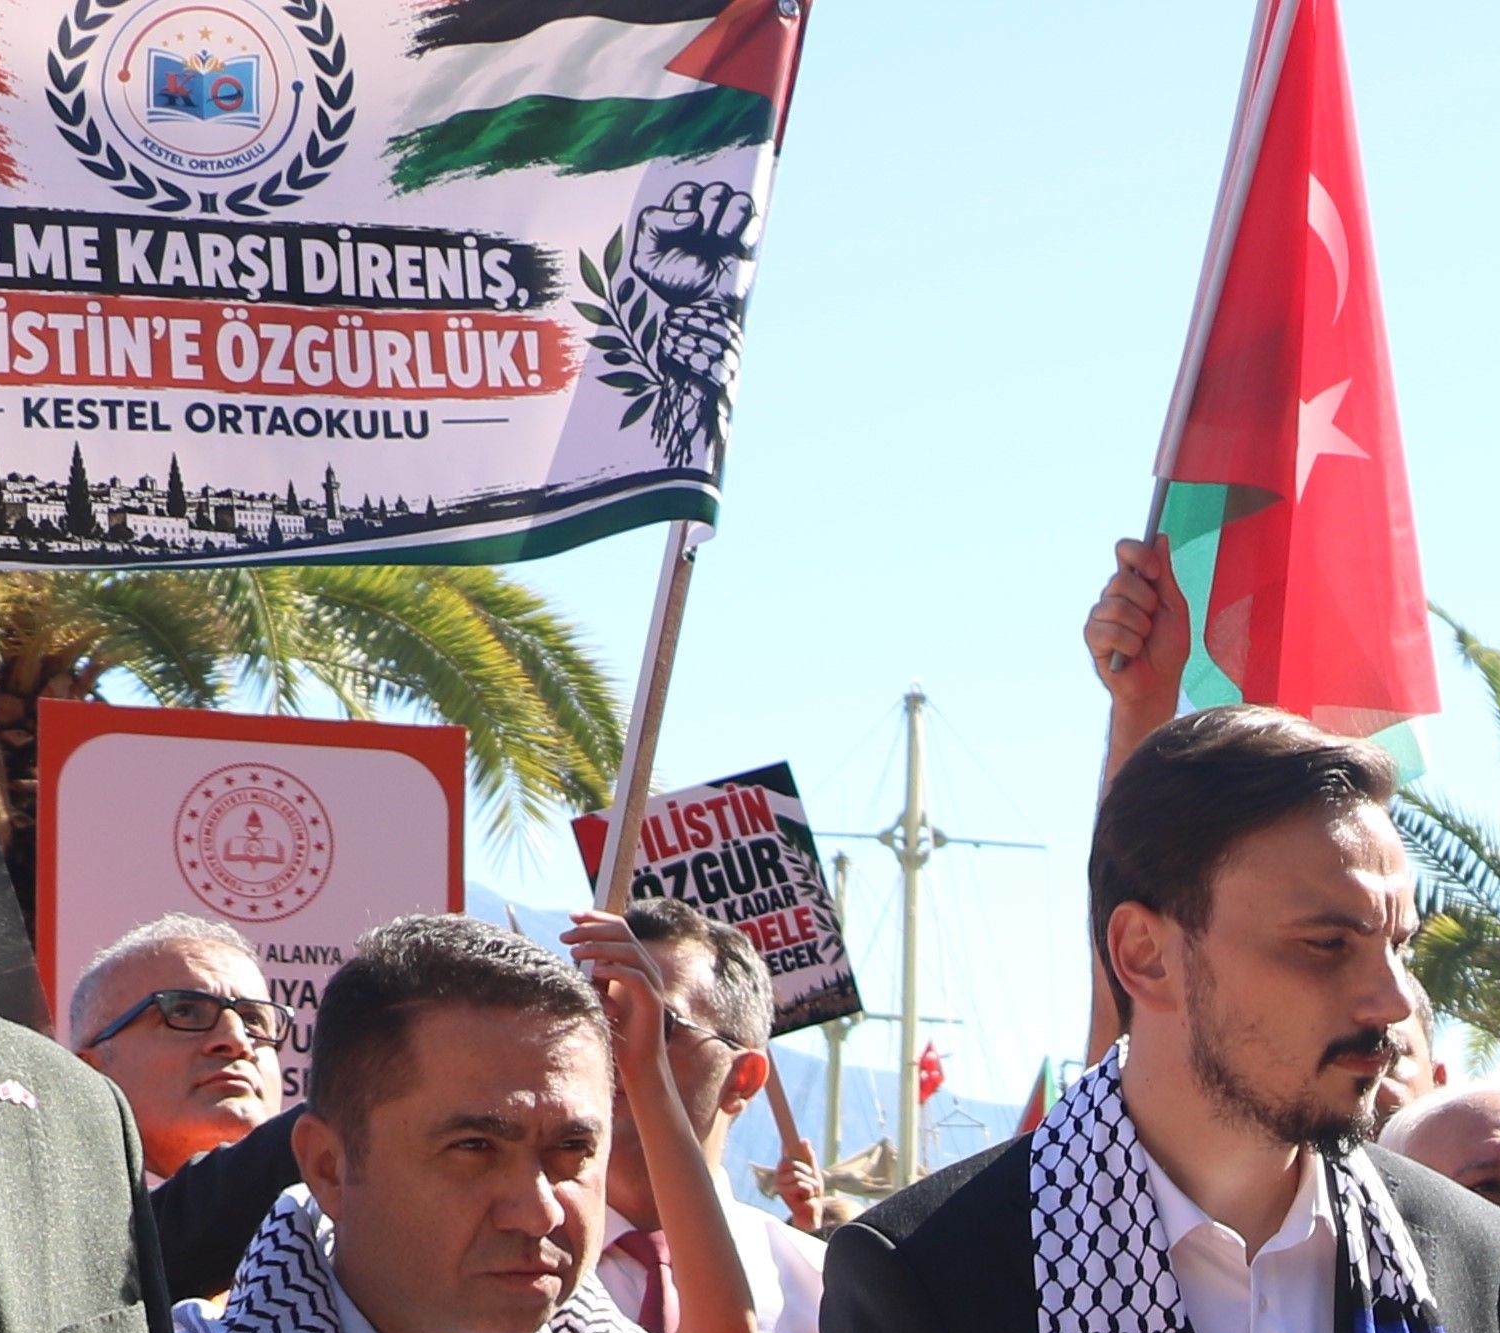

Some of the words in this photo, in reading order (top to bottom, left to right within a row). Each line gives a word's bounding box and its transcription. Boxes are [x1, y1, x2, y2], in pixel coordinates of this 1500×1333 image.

[140, 136, 184, 167] KESTEL
[188, 142, 267, 172] ORTAOKULU
[115, 227, 288, 300] KARŞI
[300, 227, 530, 310] DİRENİŞ,
[216, 306, 543, 389] ÖZGÜRLÜK!
[22, 396, 172, 432] KESTEL
[184, 401, 430, 440] ORTAOKULU
[640, 783, 776, 863] İLİSTİN
[631, 837, 790, 908] ÖZGÜR
[724, 883, 799, 924] KADAR
[266, 944, 343, 965] ALANYA
[771, 940, 825, 976] ECEK
